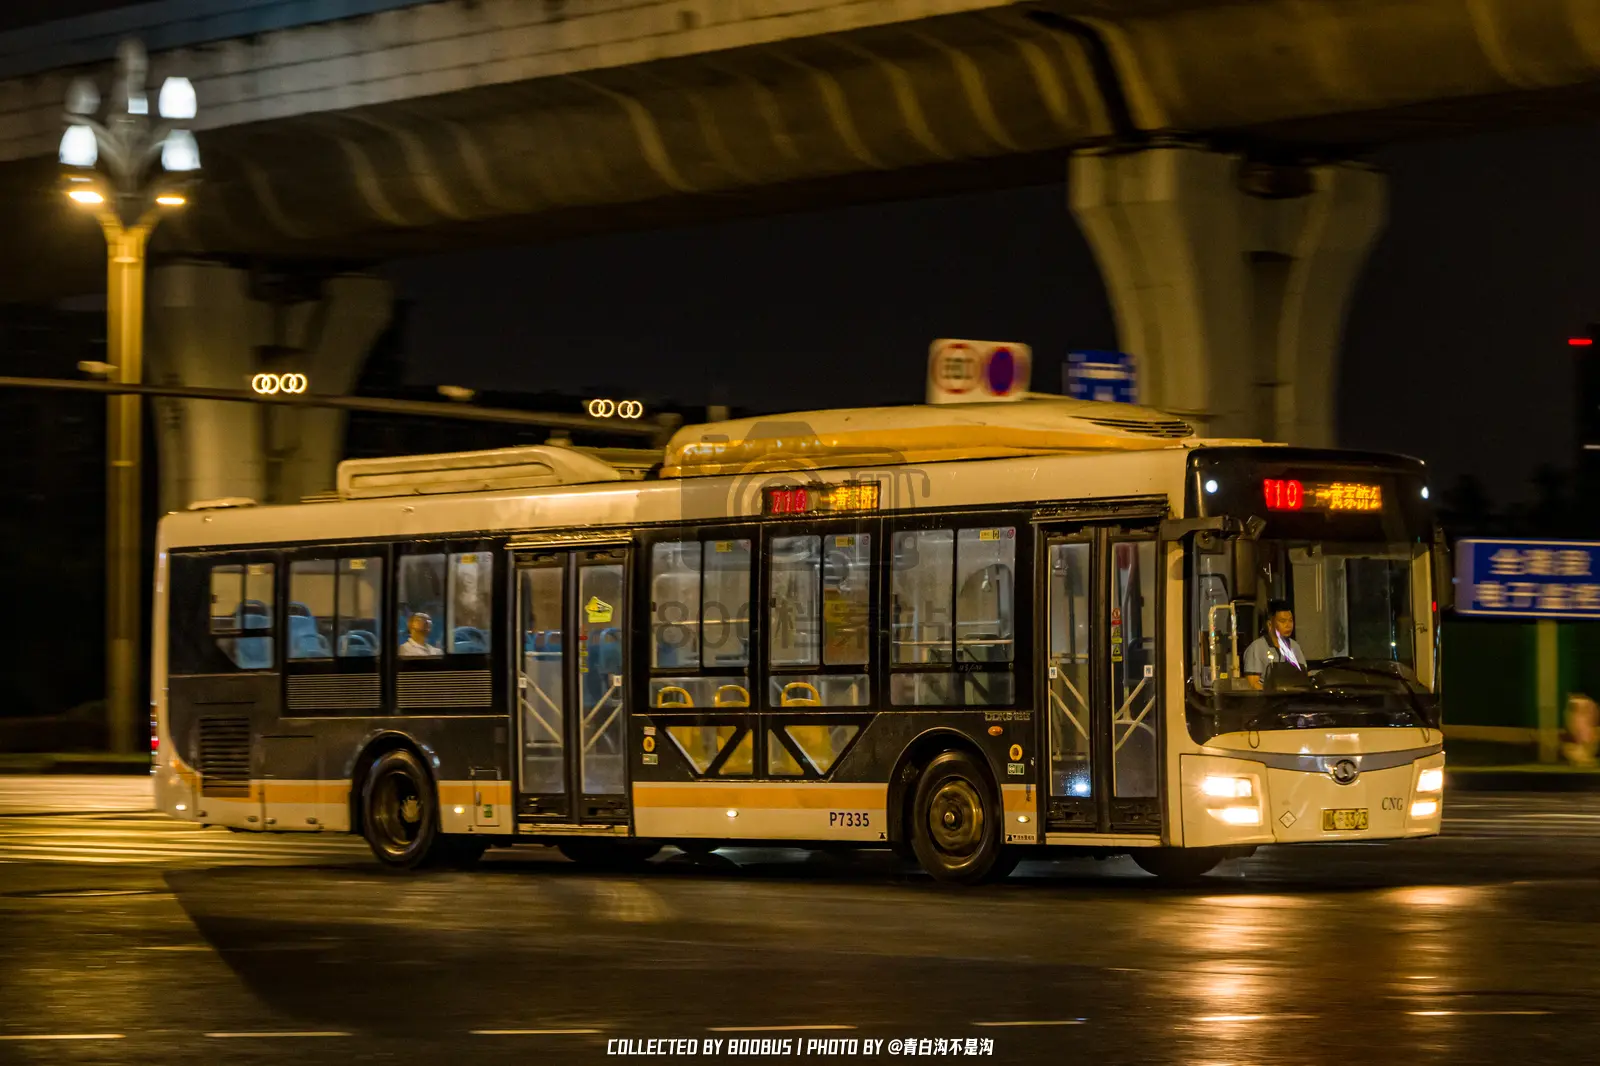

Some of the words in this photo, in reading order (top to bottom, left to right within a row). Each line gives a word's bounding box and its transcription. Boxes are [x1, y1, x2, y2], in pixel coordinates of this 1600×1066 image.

[770, 487, 808, 513] 710
[1381, 797, 1404, 811] CNG
[829, 811, 870, 827] P7335
